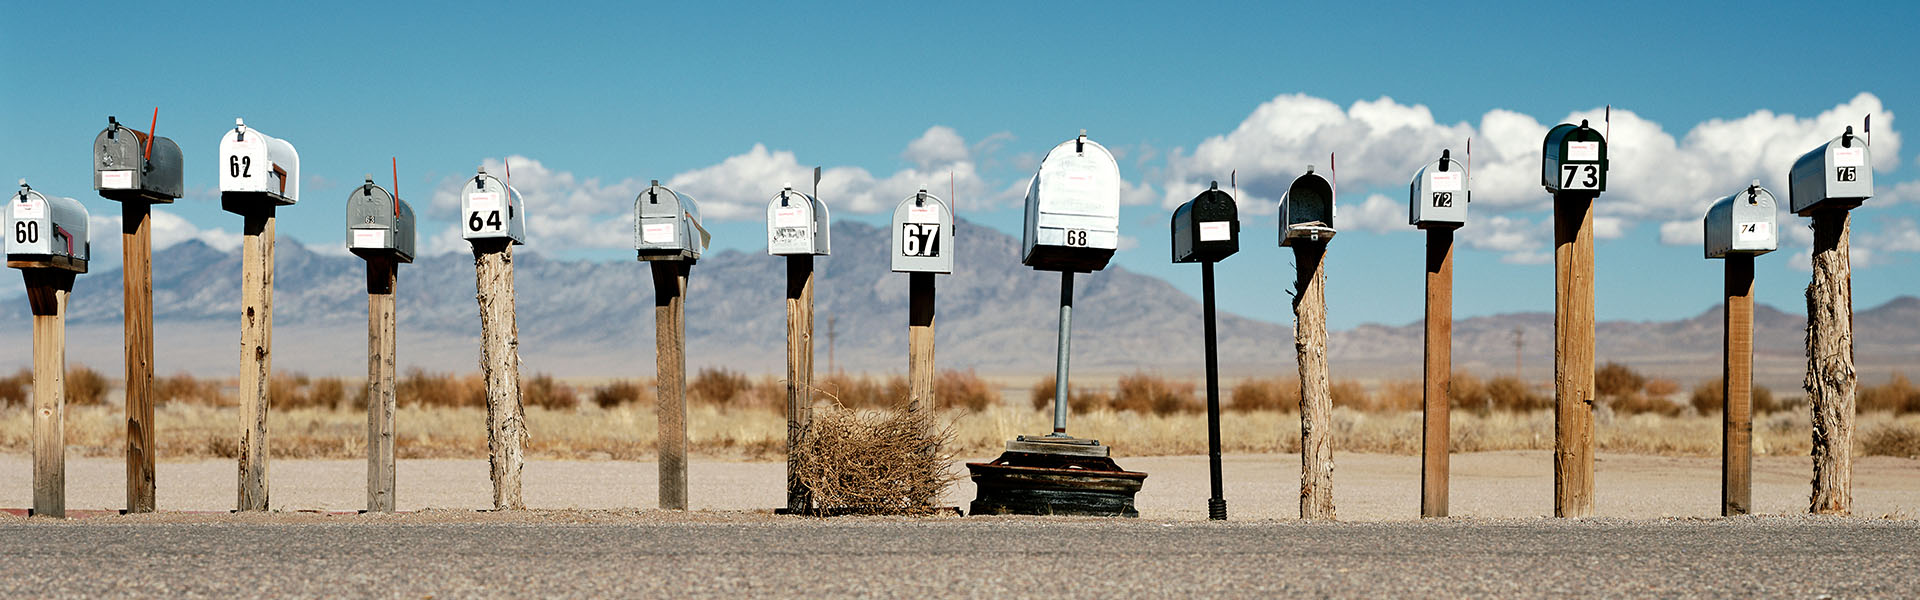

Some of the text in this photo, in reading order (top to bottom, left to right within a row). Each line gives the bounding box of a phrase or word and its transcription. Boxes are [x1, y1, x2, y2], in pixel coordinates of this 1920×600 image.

[230, 155, 252, 178] 62
[1838, 167, 1856, 181] 75
[1563, 165, 1598, 188] 73
[1433, 192, 1452, 207] 72
[365, 215, 376, 224] 63
[468, 210, 502, 231] 64
[1741, 223, 1756, 234] 74
[15, 220, 39, 244] 60
[903, 223, 940, 257] 67
[1066, 230, 1087, 246] 68
